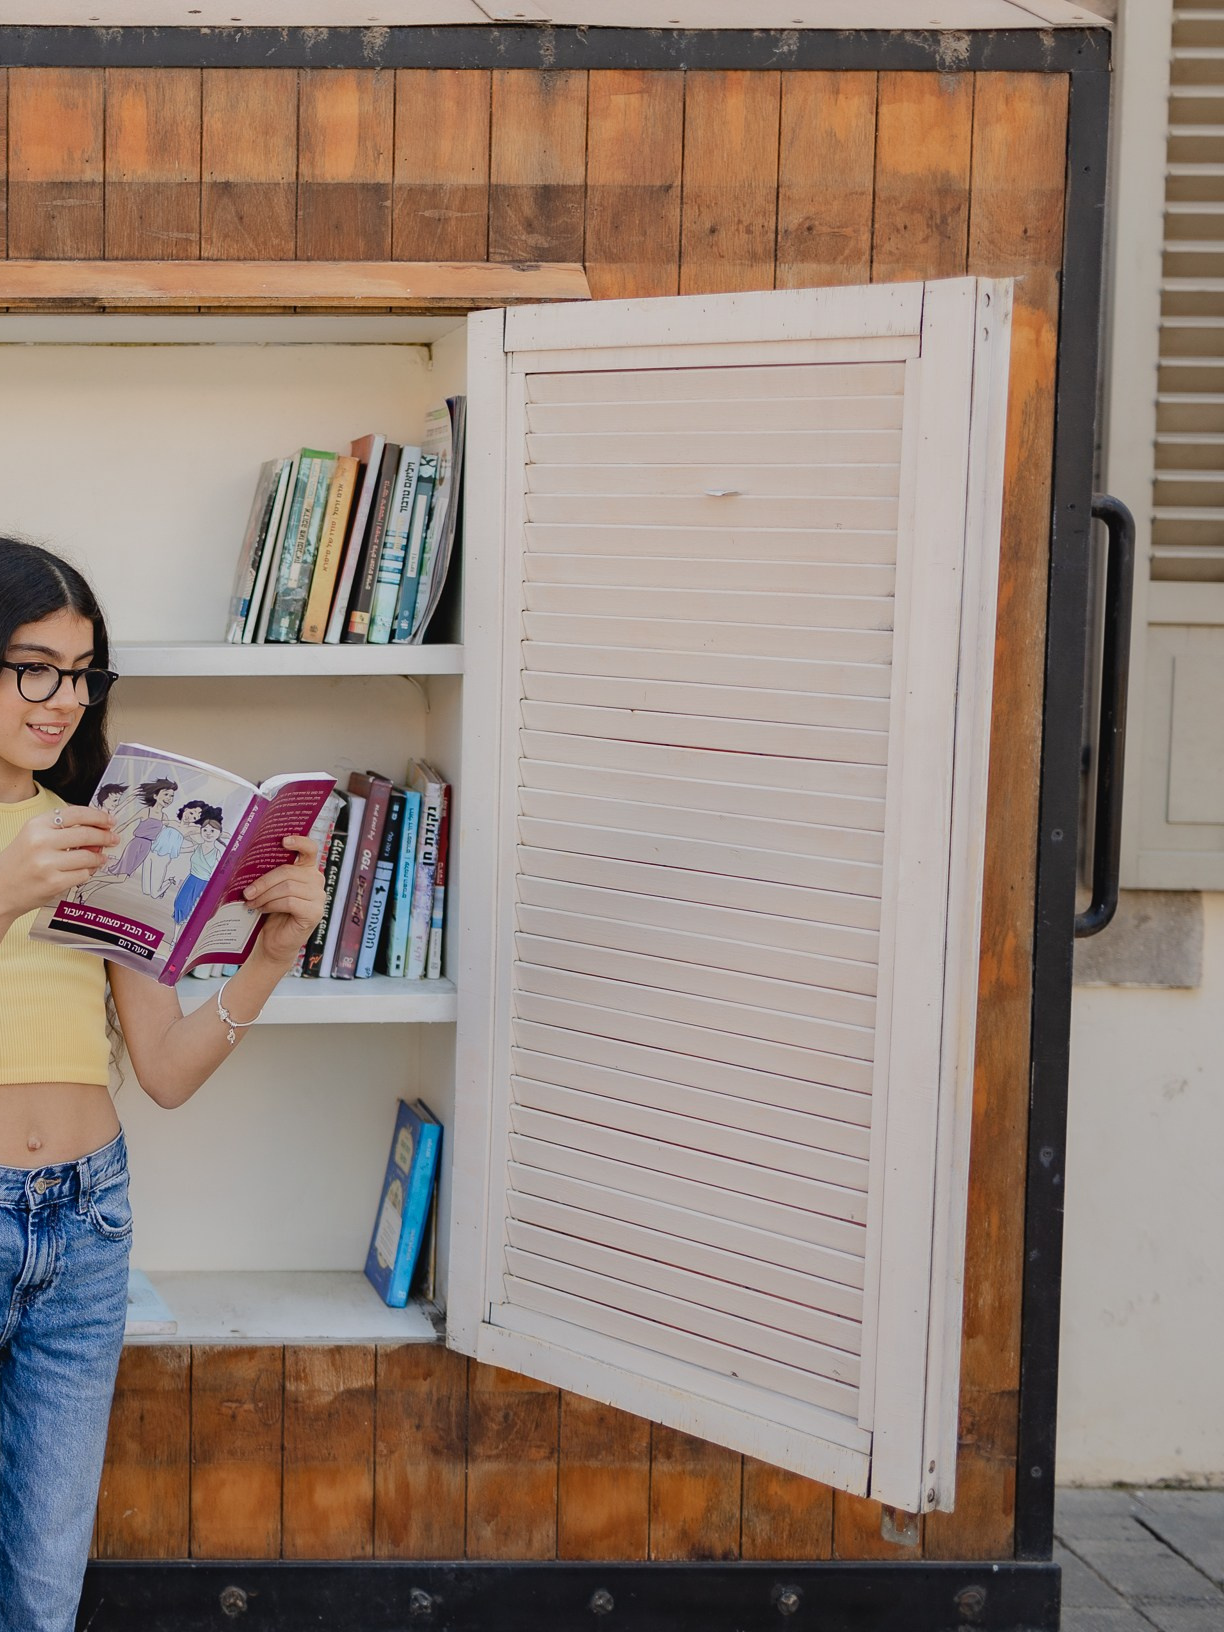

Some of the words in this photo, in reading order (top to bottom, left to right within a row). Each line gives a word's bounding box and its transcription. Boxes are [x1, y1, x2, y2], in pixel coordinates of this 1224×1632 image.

[402, 461, 414, 487] ויליאם
[331, 499, 340, 516] זרטל
[399, 489, 410, 513] טרבור
[300, 507, 311, 528] אירופה
[321, 549, 331, 571] סיסרא
[423, 805, 439, 847] נקודת
[329, 838, 345, 862] קניה
[360, 848, 372, 871] ספר
[422, 851, 435, 866] חן
[327, 865, 338, 885] ערכת
[63, 907, 84, 917] יעבור
[364, 899, 382, 949] ההצהרה
[118, 938, 131, 947] רום
[144, 931, 156, 941] עד
[131, 944, 149, 956] נועה
